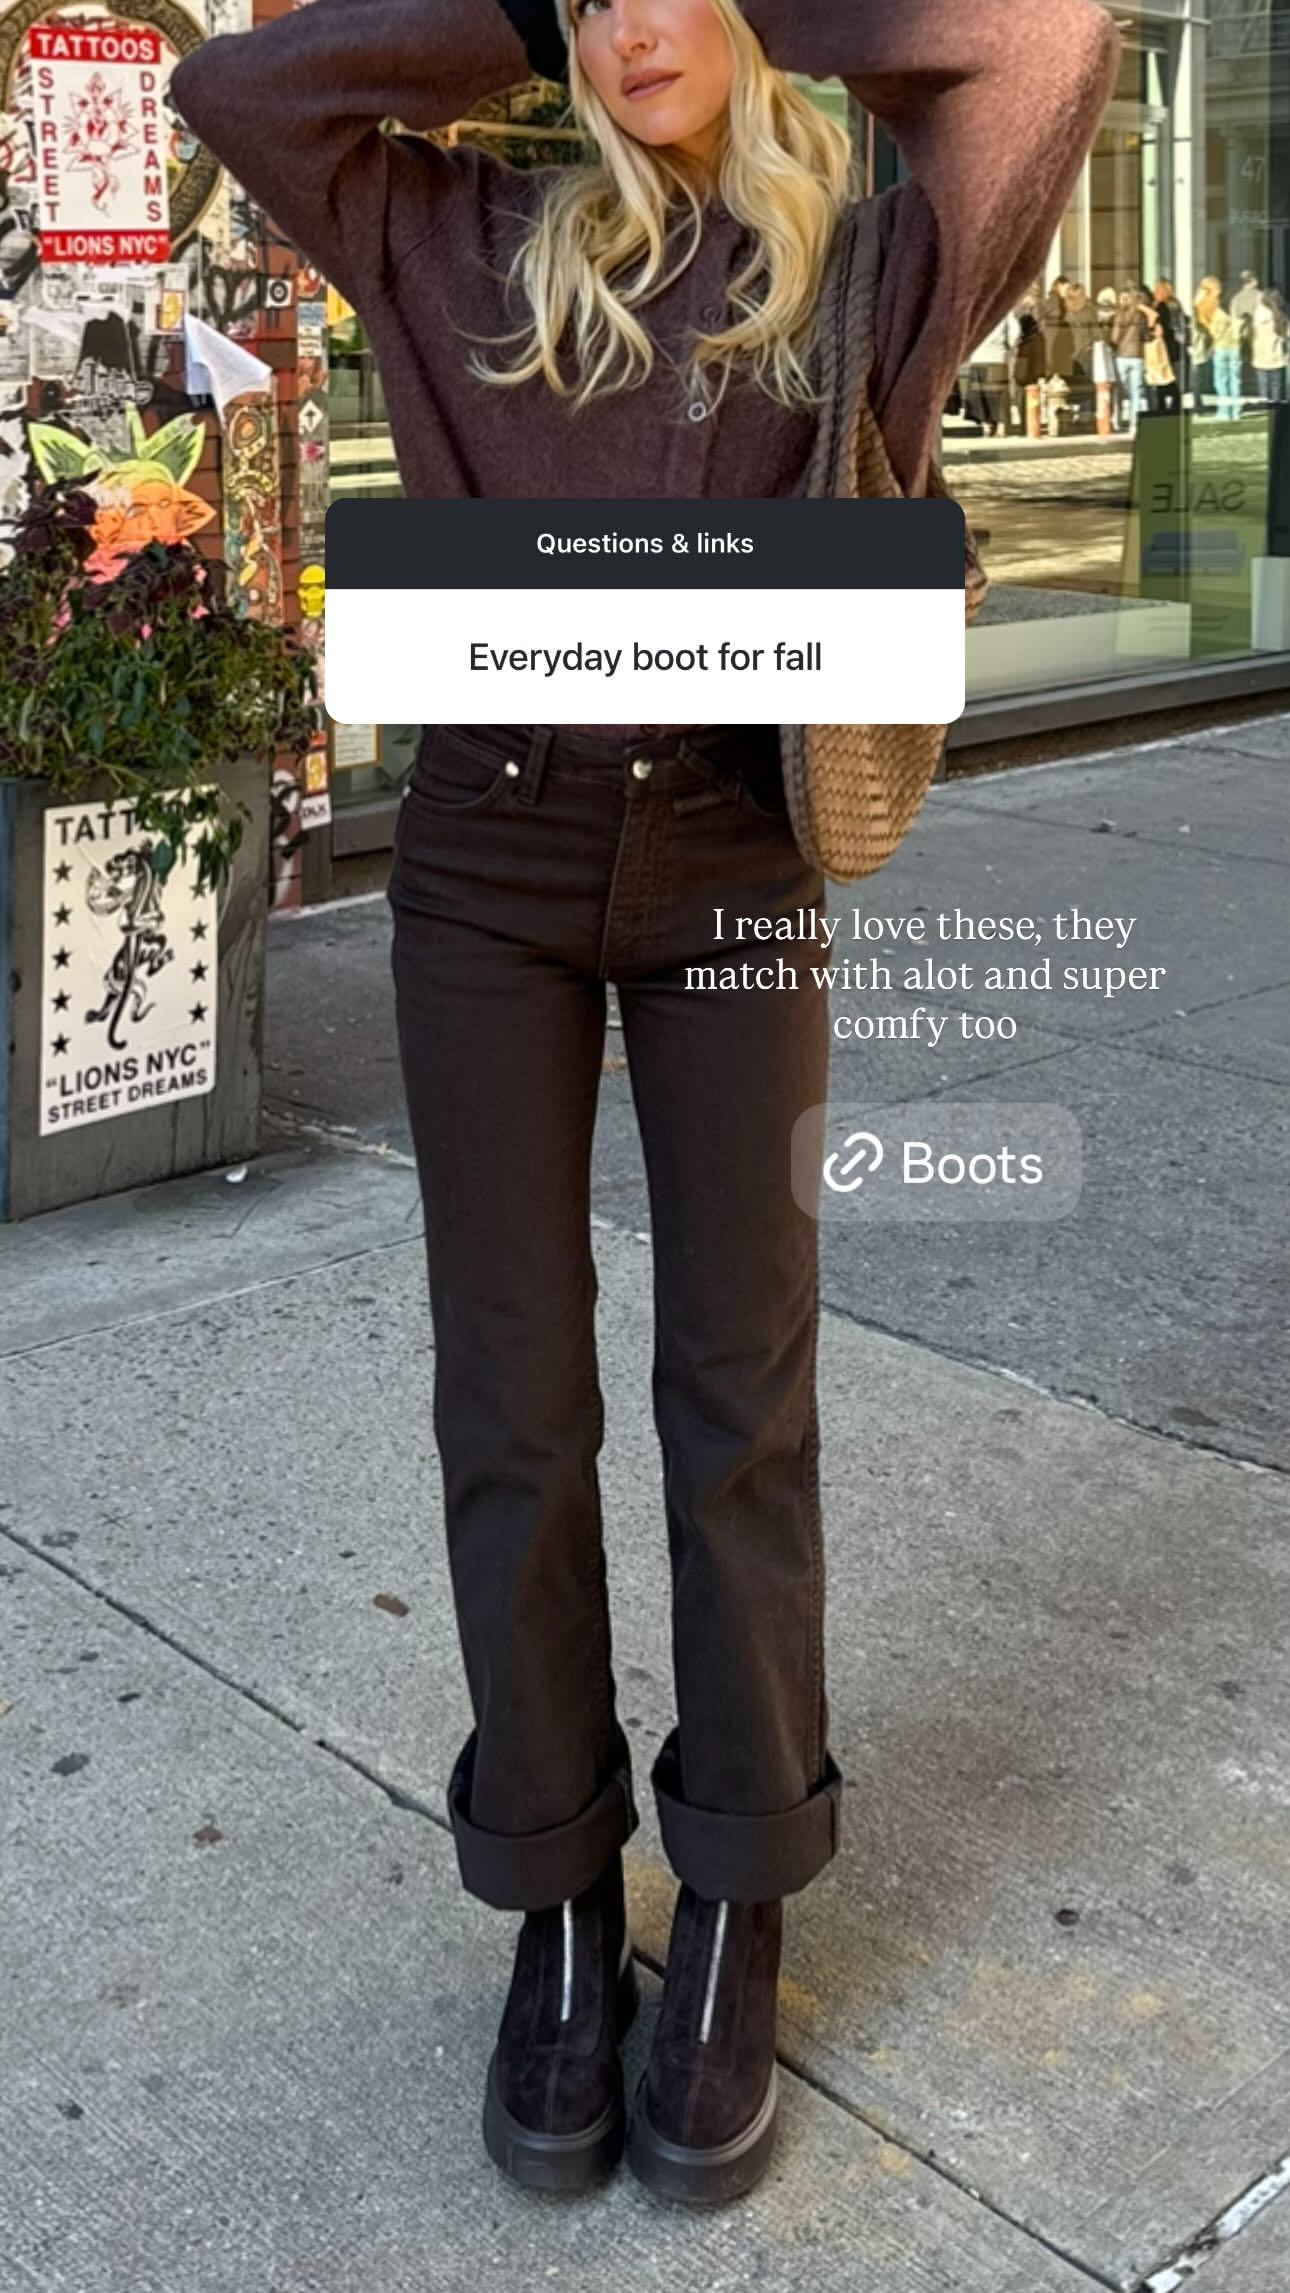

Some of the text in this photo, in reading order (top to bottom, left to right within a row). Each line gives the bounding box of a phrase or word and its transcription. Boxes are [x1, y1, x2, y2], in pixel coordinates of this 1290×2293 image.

[36, 33, 154, 60] TATTOOS
[37, 67, 60, 223] STREET
[139, 71, 163, 223] DREAMS
[48, 1068, 208, 1124] STREET DREAMS
